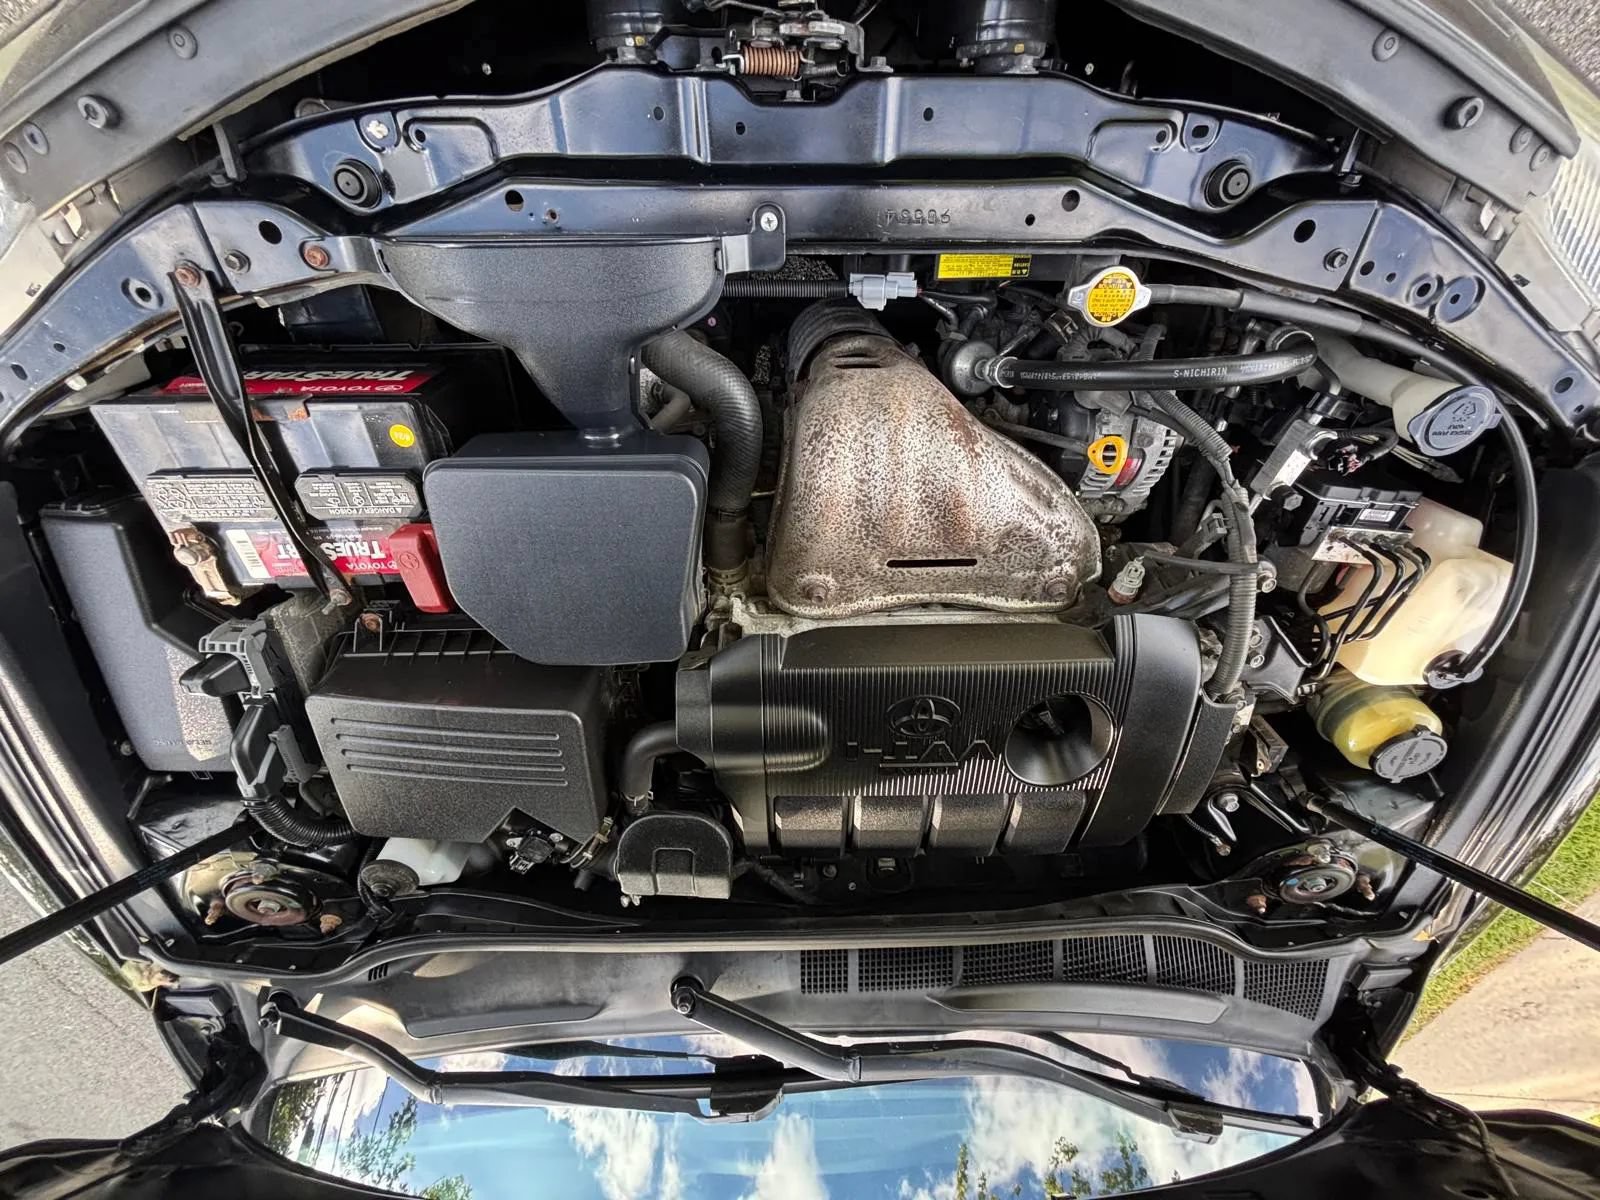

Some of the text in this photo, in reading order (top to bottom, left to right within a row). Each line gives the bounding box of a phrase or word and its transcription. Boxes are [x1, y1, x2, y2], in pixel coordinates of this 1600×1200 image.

[300, 384, 373, 393] TOYOTA
[277, 540, 386, 561] TRUESRT
[346, 561, 386, 570] TOYOTA
